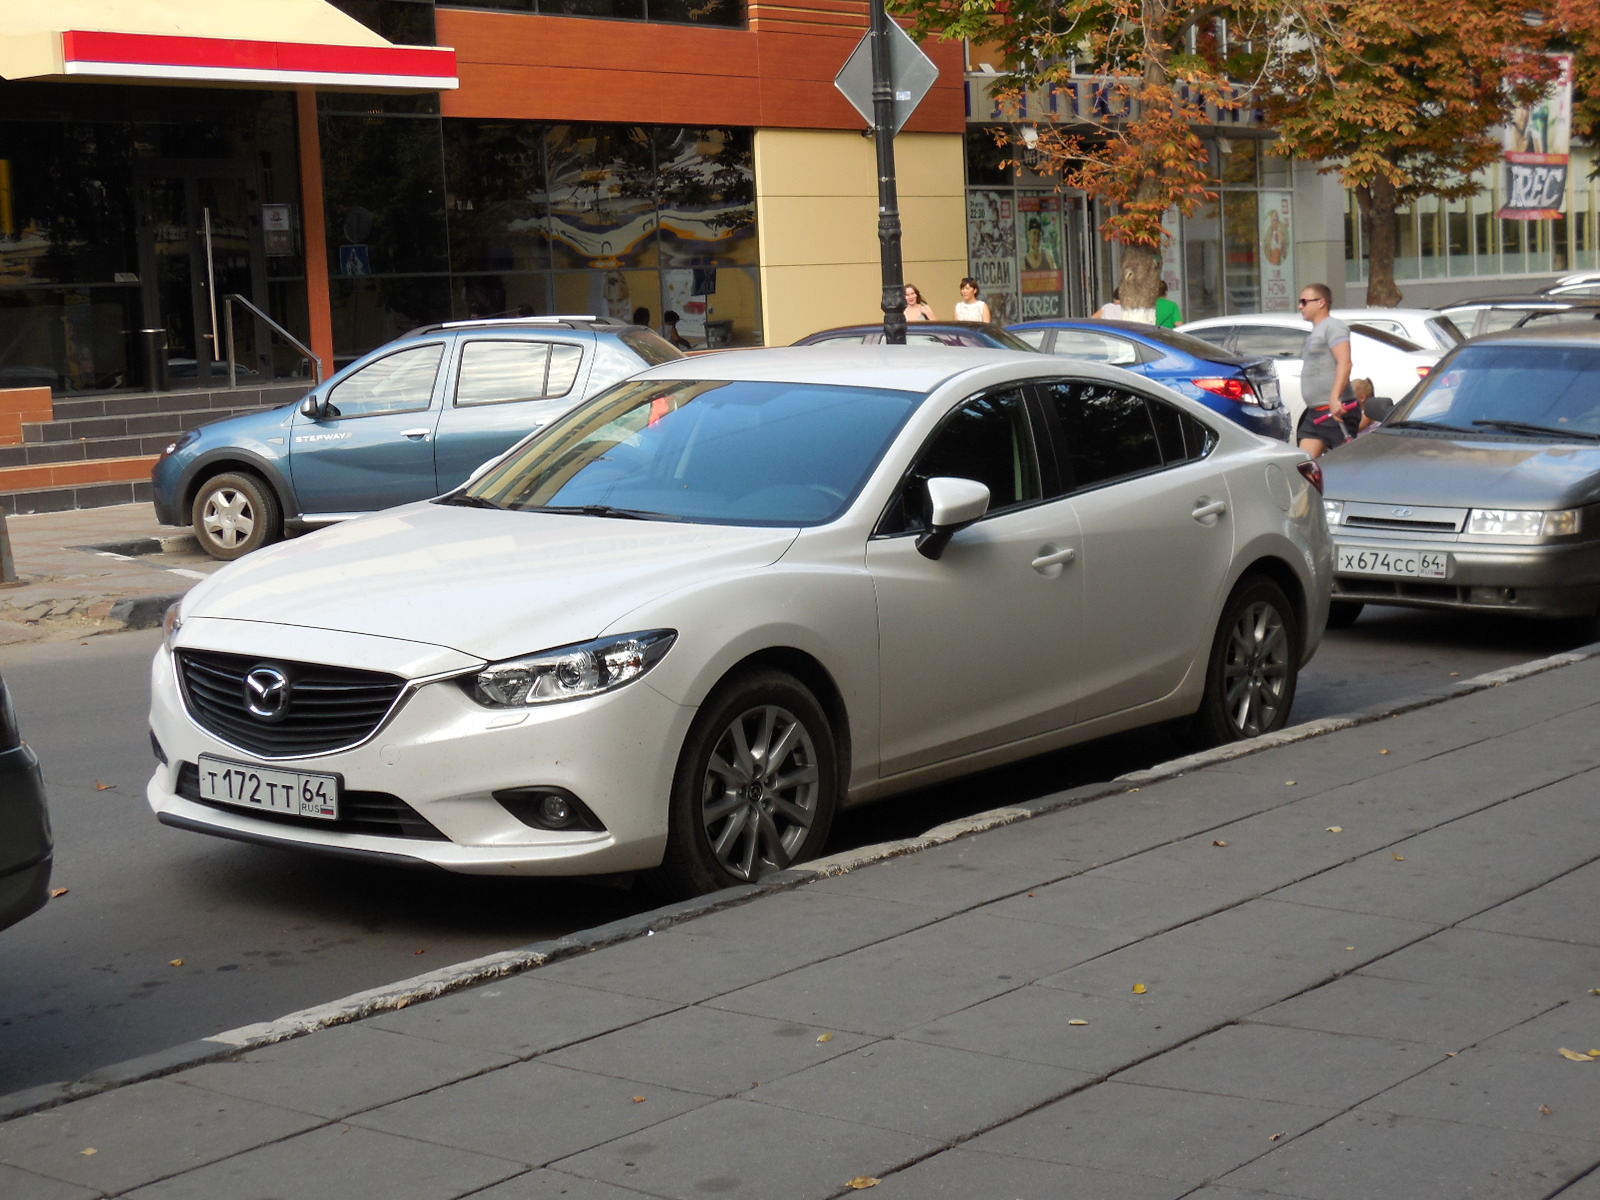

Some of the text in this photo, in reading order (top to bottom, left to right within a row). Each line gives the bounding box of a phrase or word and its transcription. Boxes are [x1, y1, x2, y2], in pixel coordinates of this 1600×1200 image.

[295, 432, 346, 443] STEPWAY
[1421, 555, 1440, 569] 64
[302, 780, 327, 804] 64
[301, 803, 320, 813] RUS
